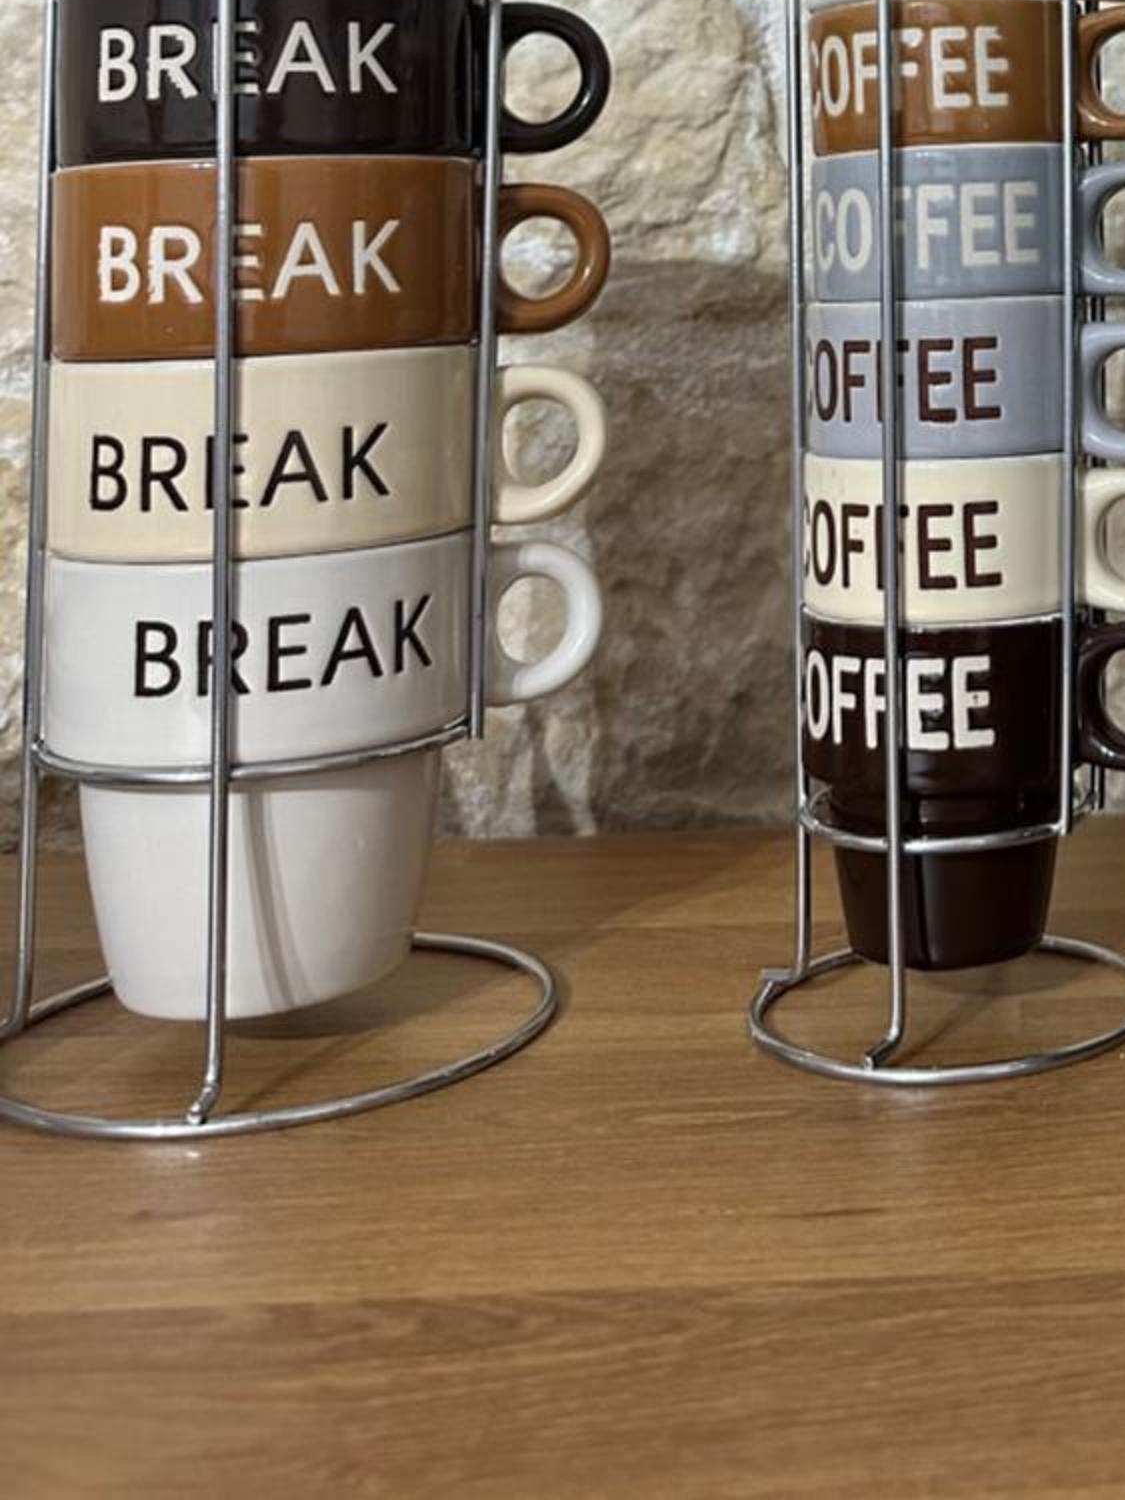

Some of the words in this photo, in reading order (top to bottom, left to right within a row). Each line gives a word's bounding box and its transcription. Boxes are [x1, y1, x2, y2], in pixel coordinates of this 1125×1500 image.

[97, 21, 398, 102] BREAK
[816, 180, 1041, 273] COFEE
[807, 336, 1001, 424] OFFEE
[88, 422, 390, 513] BREAK
[133, 593, 434, 699] BREAK
[802, 648, 995, 751] OFFEE
